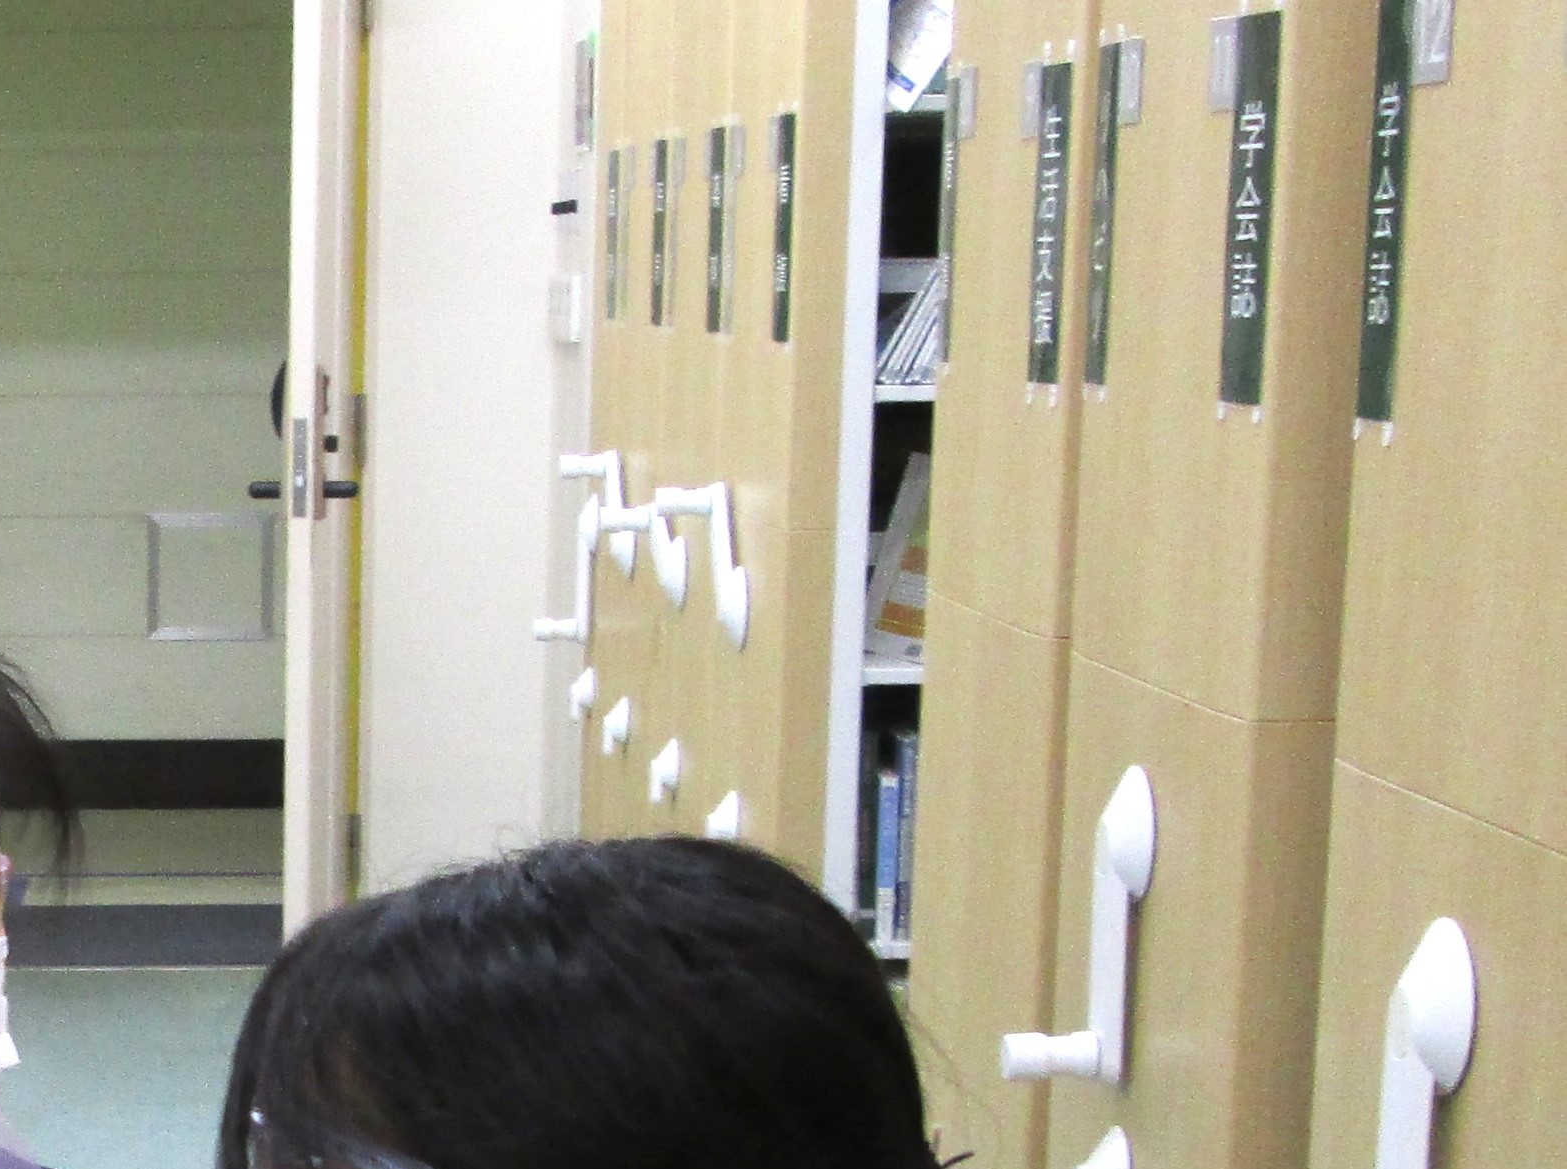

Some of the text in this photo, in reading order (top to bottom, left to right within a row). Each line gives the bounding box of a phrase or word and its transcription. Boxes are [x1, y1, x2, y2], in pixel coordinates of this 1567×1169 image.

[1230, 100, 1266, 319] 学会誌
[1366, 80, 1401, 325] 学会誌
